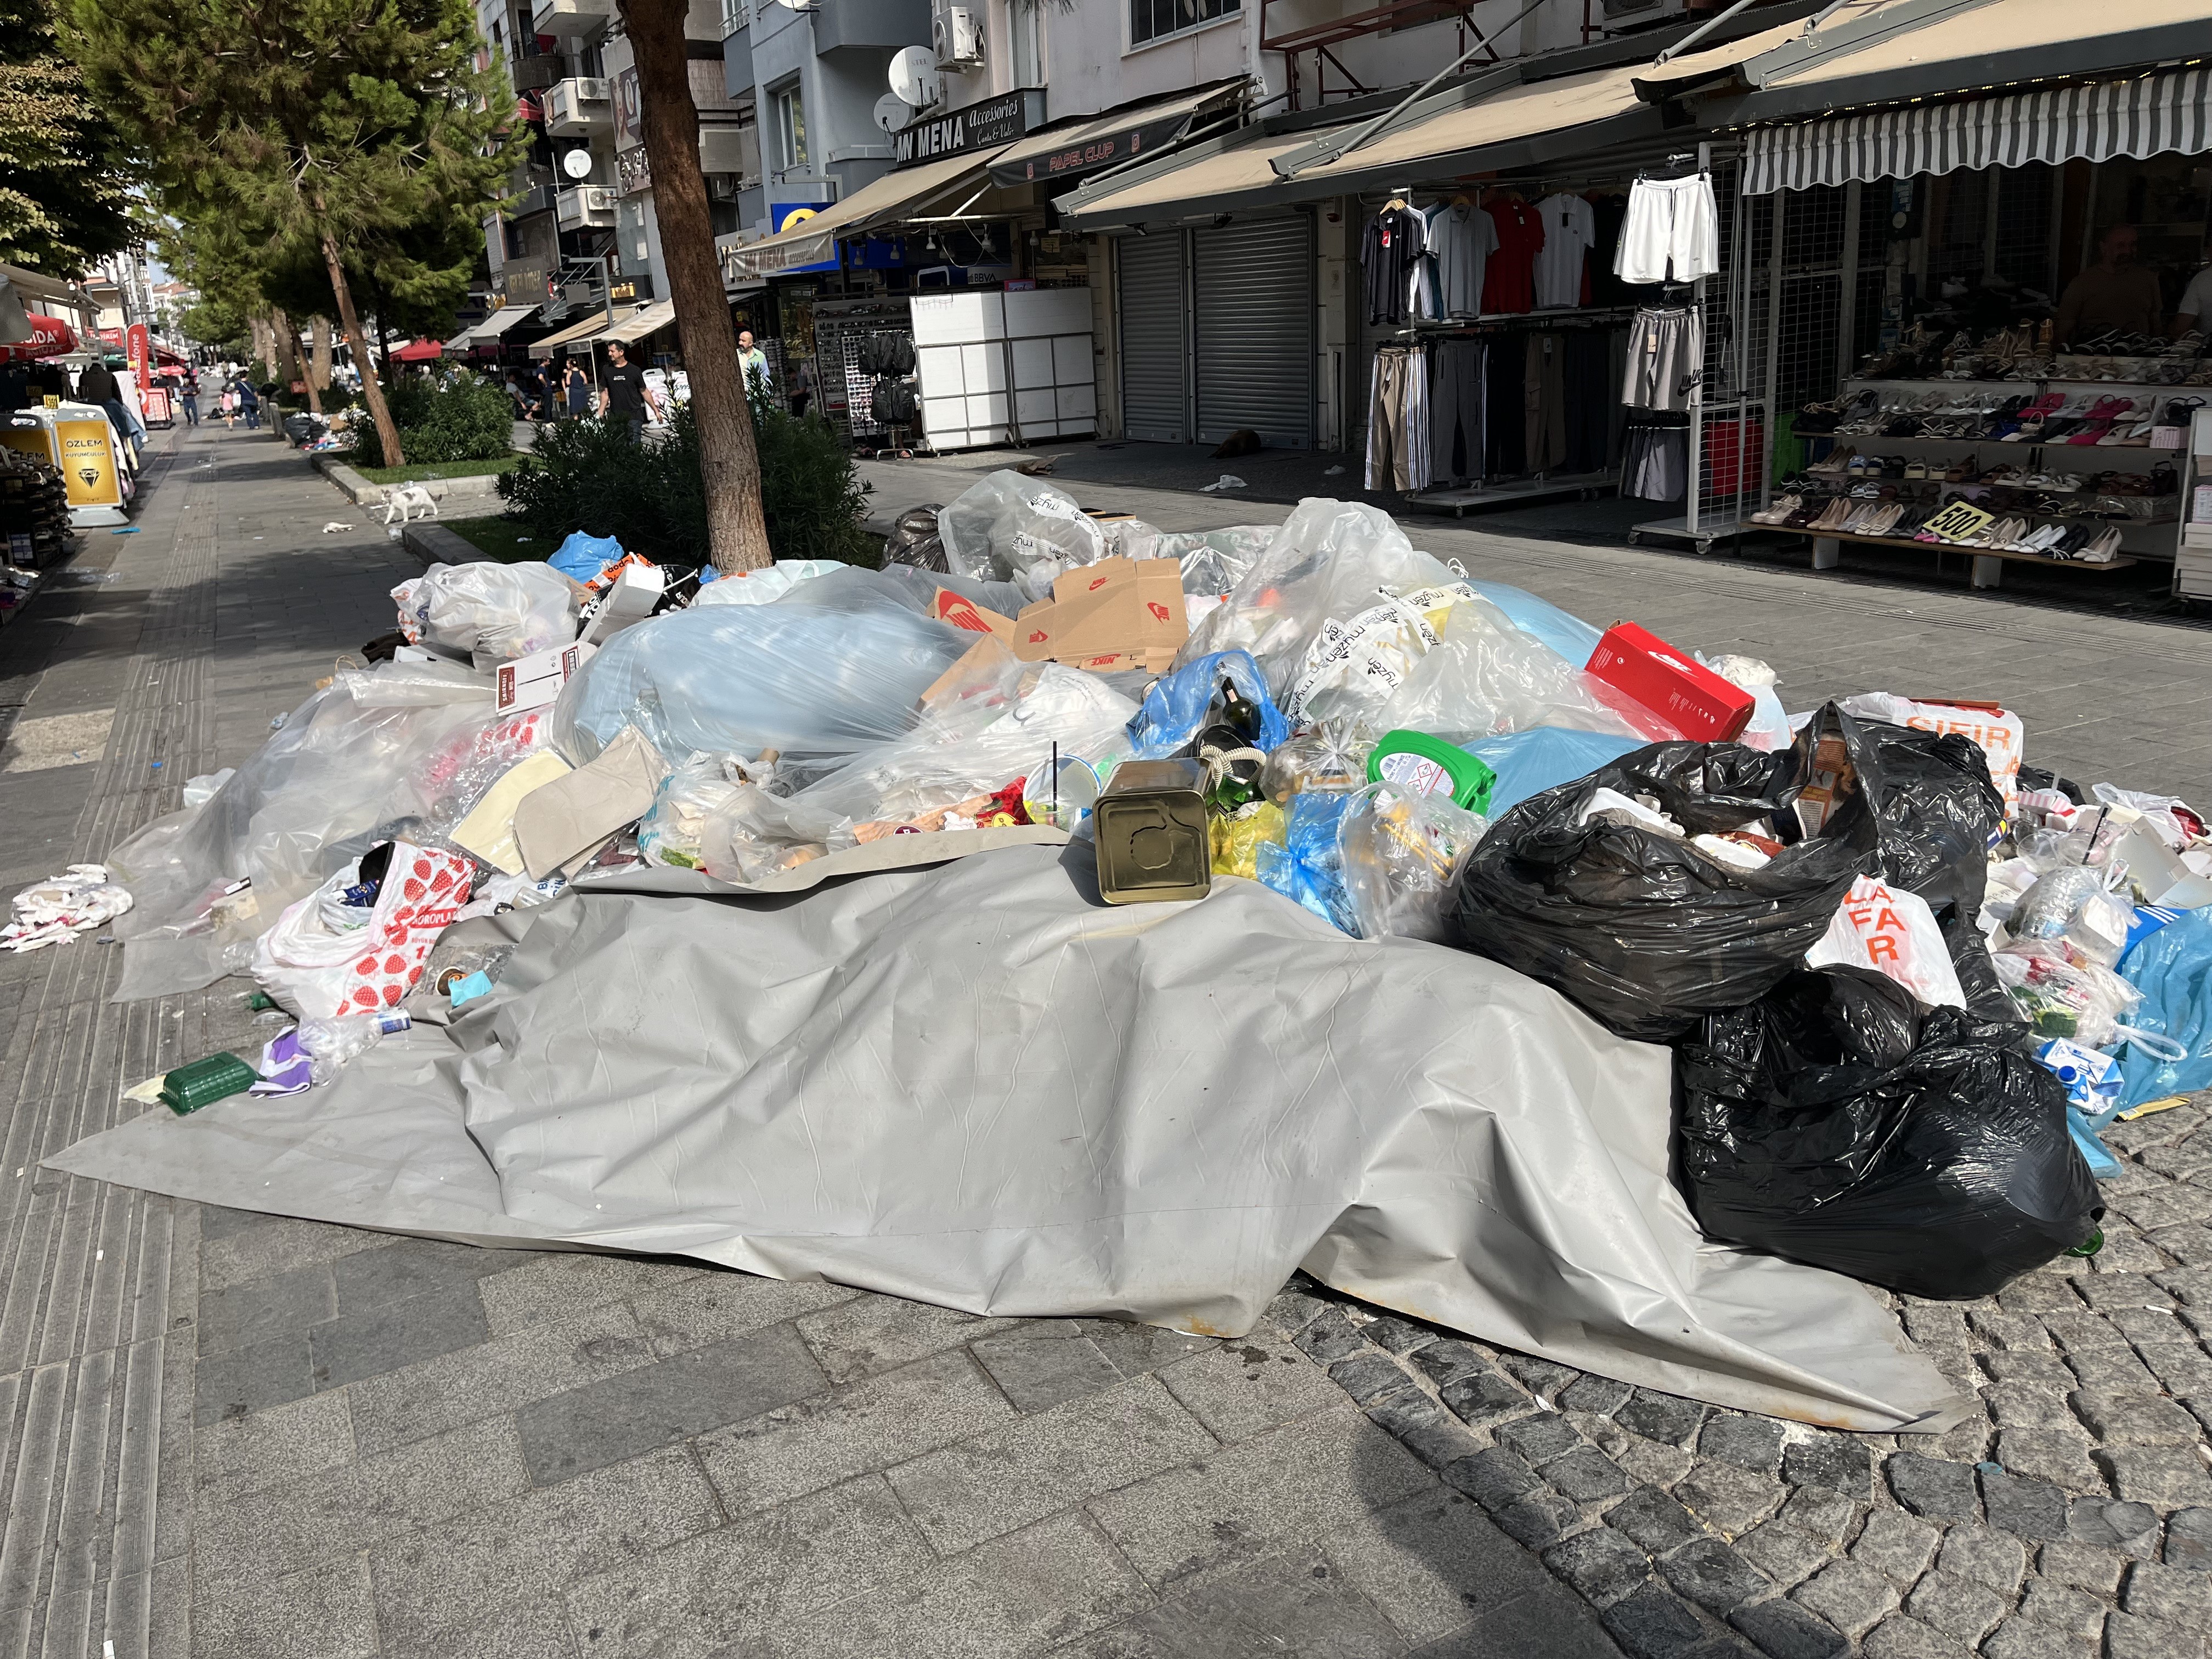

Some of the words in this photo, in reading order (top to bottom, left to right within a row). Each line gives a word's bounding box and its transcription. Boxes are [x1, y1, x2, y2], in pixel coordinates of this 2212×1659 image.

[918, 116, 964, 158] MENA
[1049, 150, 1084, 172] PAPEL
[1085, 141, 1114, 163] CLUP
[759, 247, 786, 270] MENA
[974, 273, 996, 283] BBVA
[1682, 368, 1703, 387] NIK
[1931, 506, 1982, 535] 500
[1092, 577, 1107, 586] NIKE
[1091, 657, 1116, 666] NIKE
[1658, 653, 1693, 672] NIKE
[411, 911, 458, 926] OROPLA
[416, 945, 425, 960] 1
[1866, 935, 1900, 964] R
